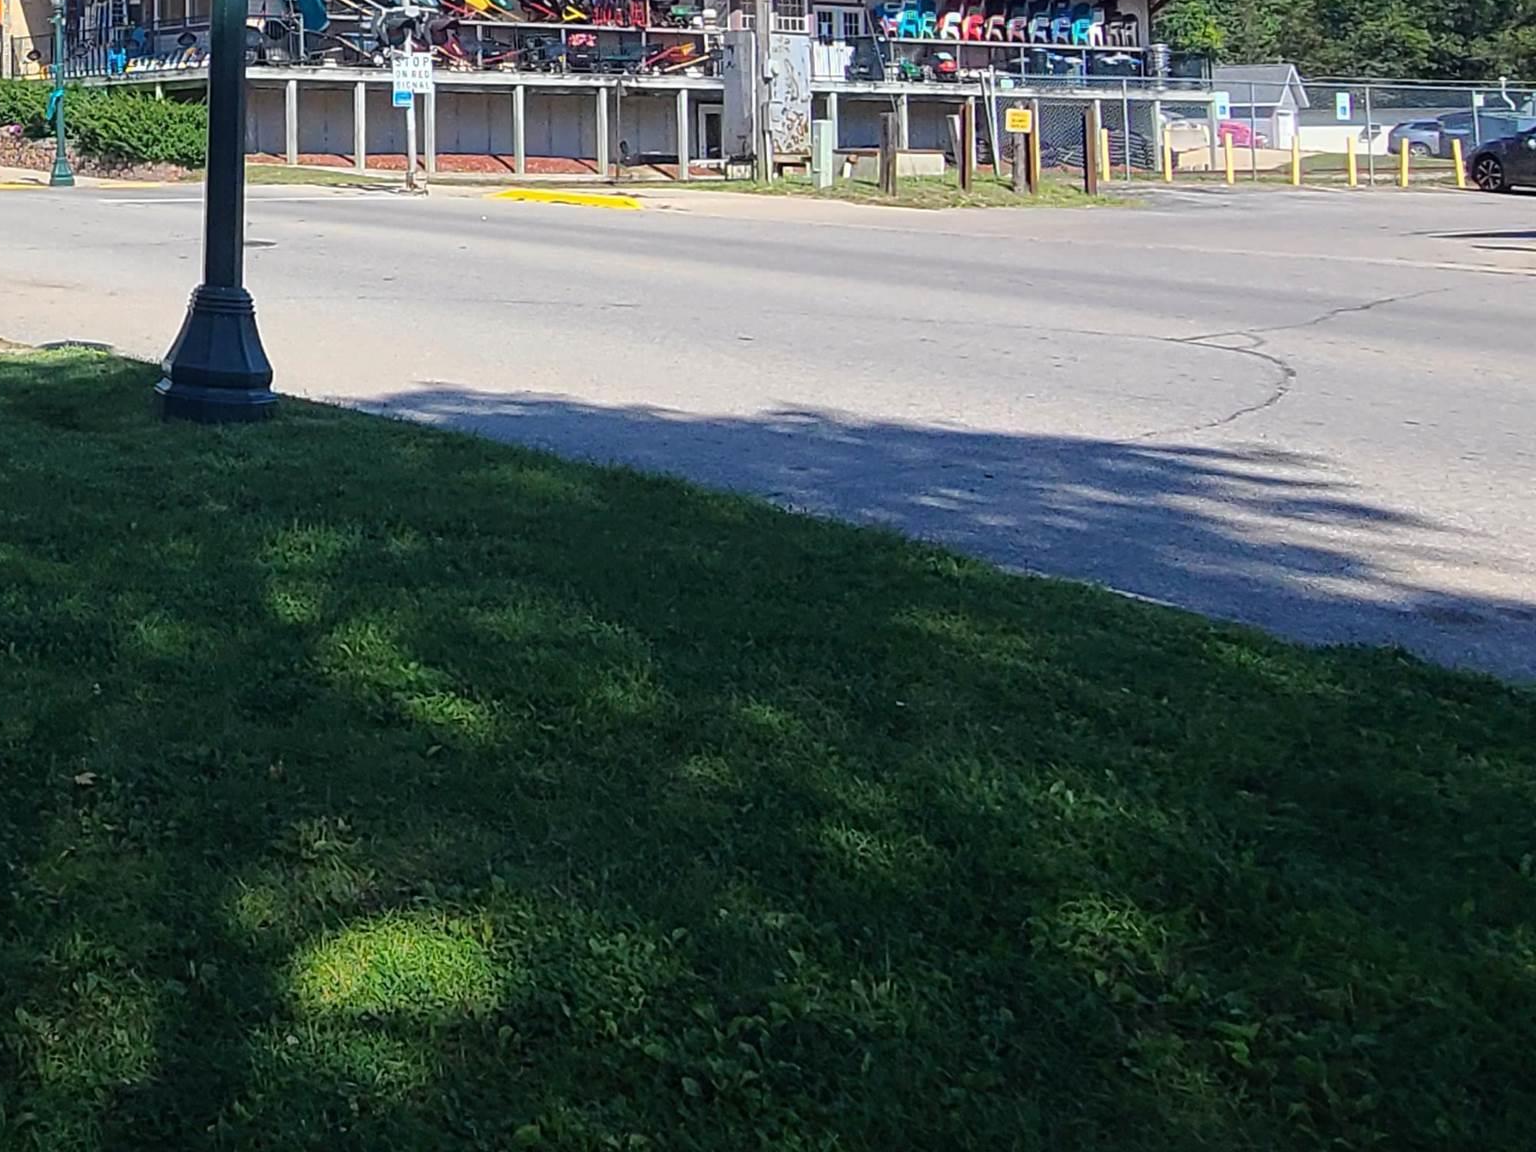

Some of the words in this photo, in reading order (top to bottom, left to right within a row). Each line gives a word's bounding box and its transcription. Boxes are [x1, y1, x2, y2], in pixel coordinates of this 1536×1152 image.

[395, 56, 430, 68] STOP
[396, 70, 408, 79] ON
[411, 70, 430, 79] RED
[396, 80, 430, 90] SIGNAL
